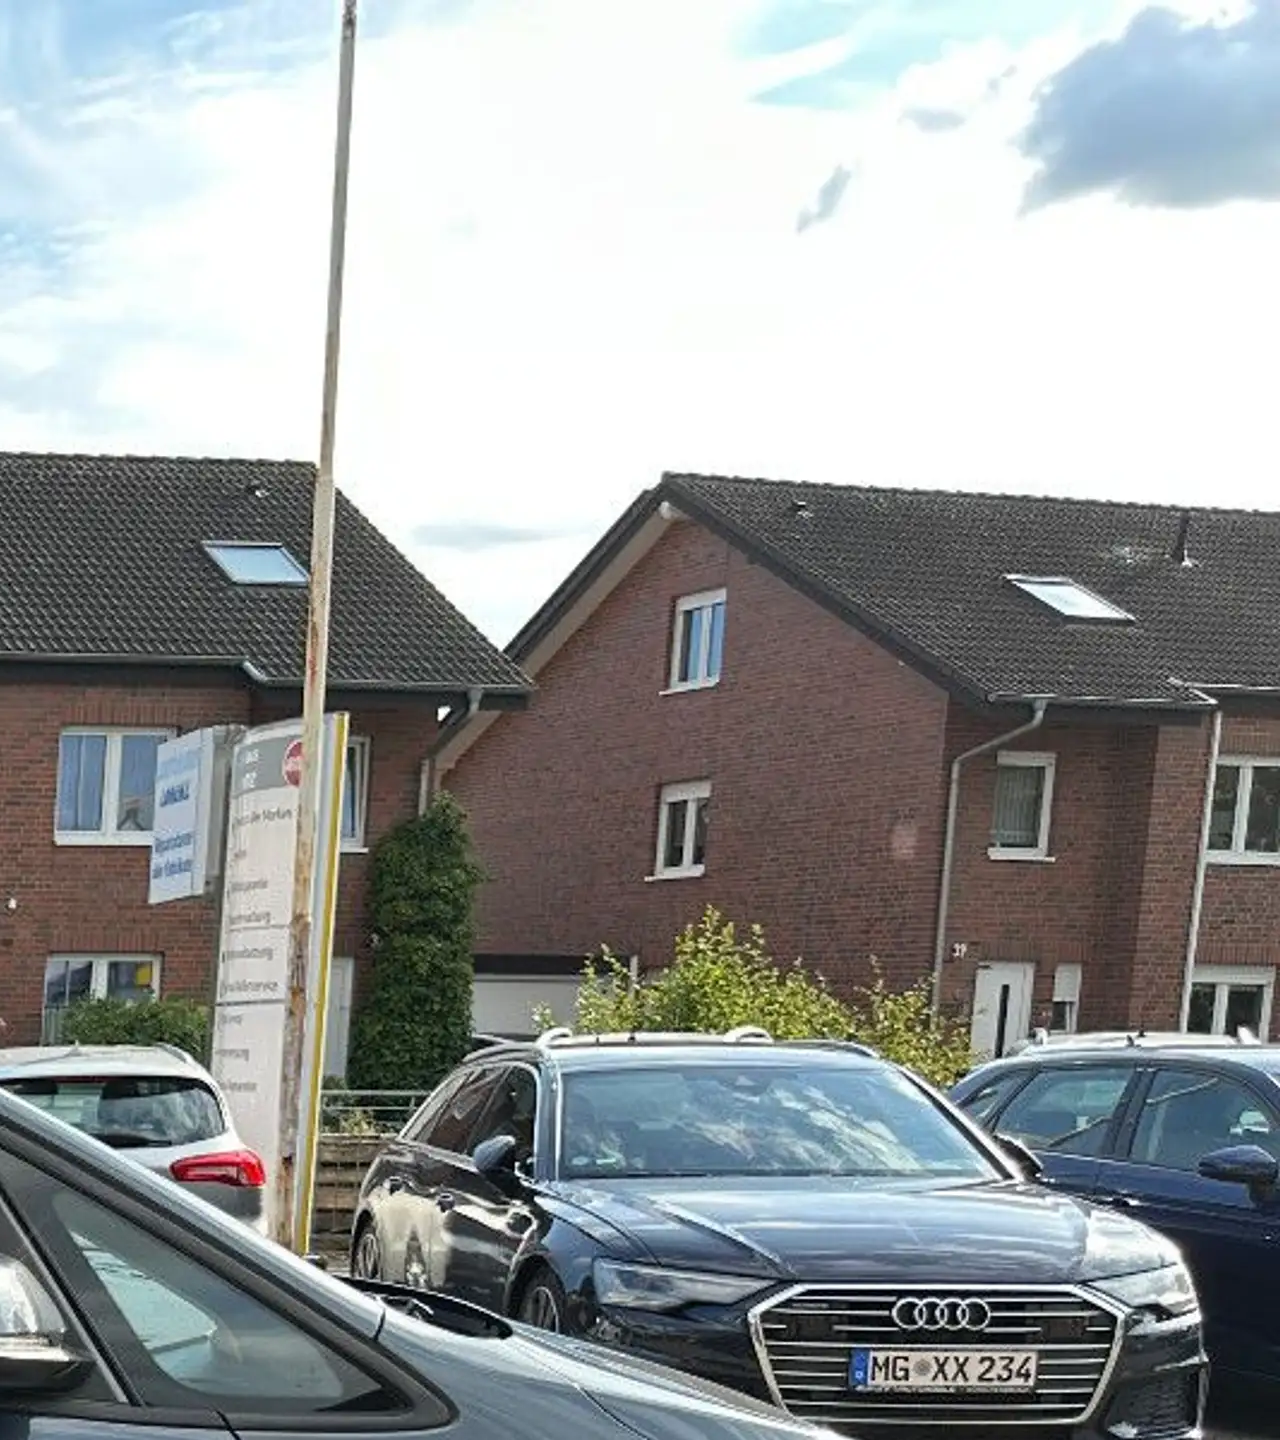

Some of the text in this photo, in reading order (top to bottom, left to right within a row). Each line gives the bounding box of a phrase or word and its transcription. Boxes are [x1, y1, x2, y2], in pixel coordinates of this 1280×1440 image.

[870, 1356, 910, 1382] MG
[932, 1356, 970, 1382] XX
[977, 1356, 1032, 1382] 234
